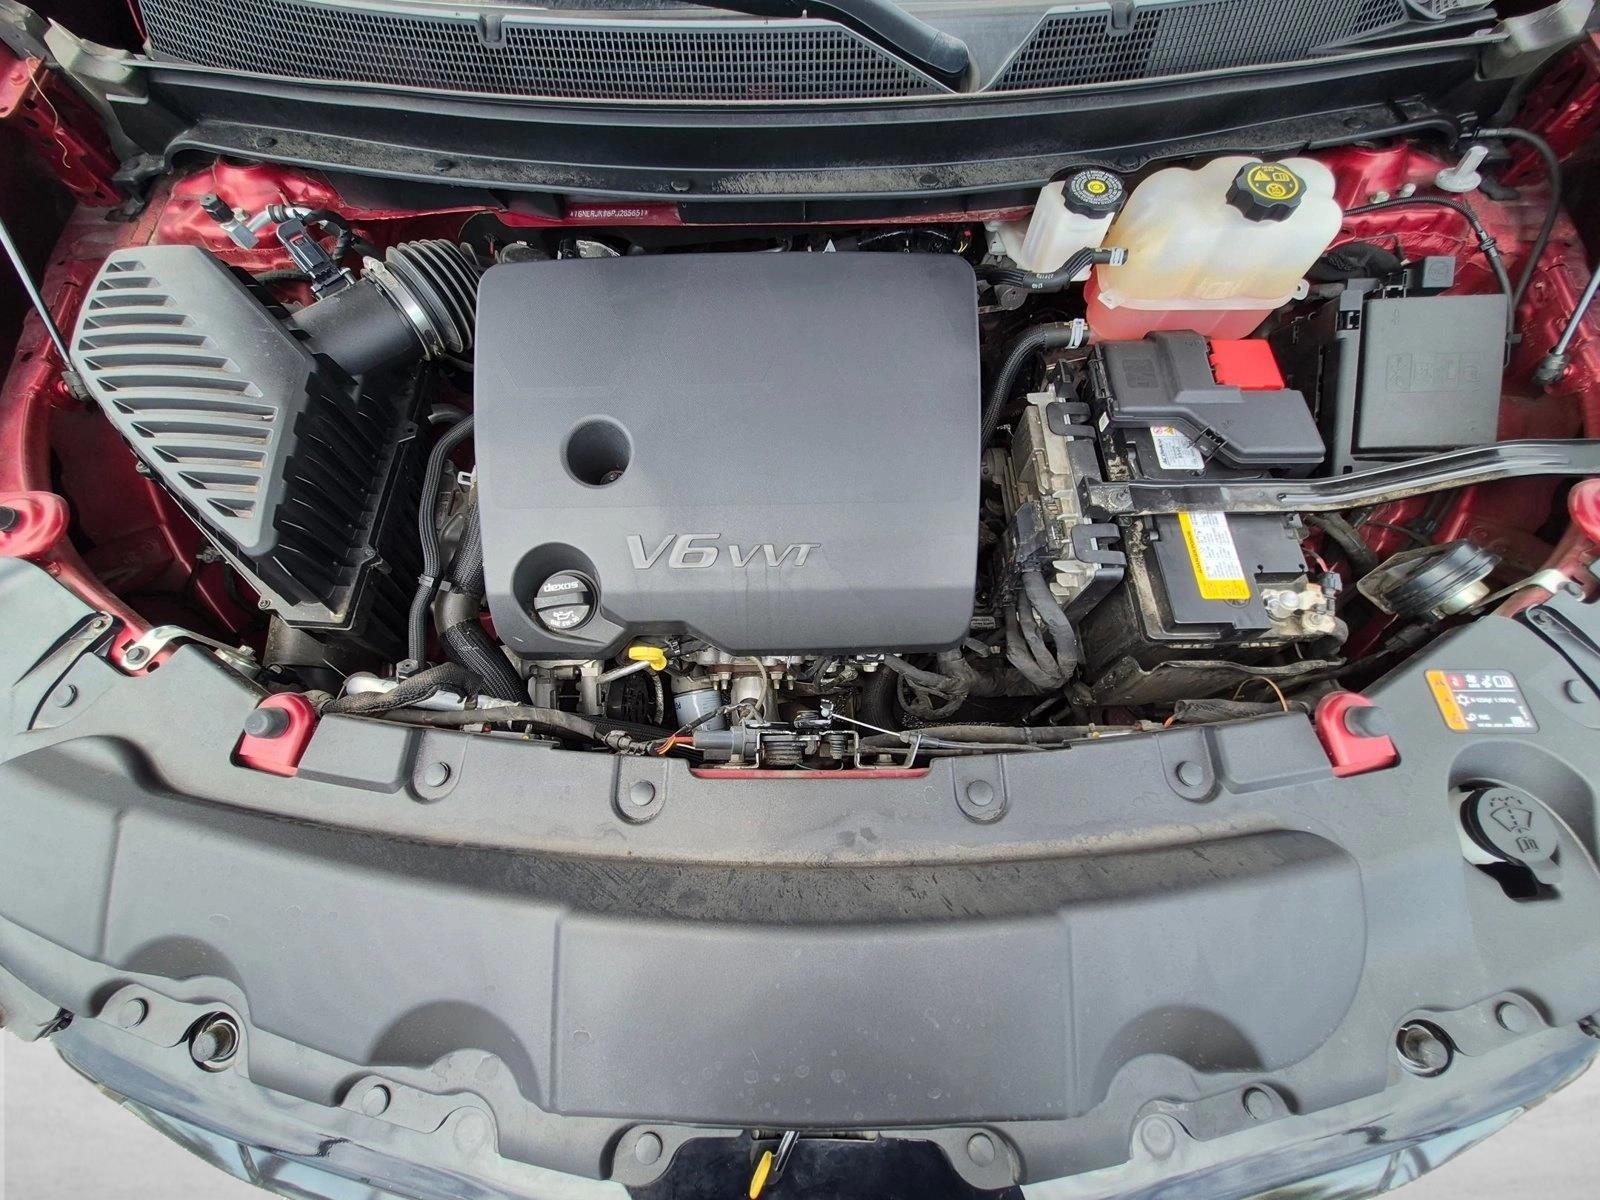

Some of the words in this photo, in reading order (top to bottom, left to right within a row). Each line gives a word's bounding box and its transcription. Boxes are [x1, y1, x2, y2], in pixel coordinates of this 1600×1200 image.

[626, 533, 721, 569] V6
[728, 543, 821, 567] VVT
[543, 581, 579, 593] dexos
